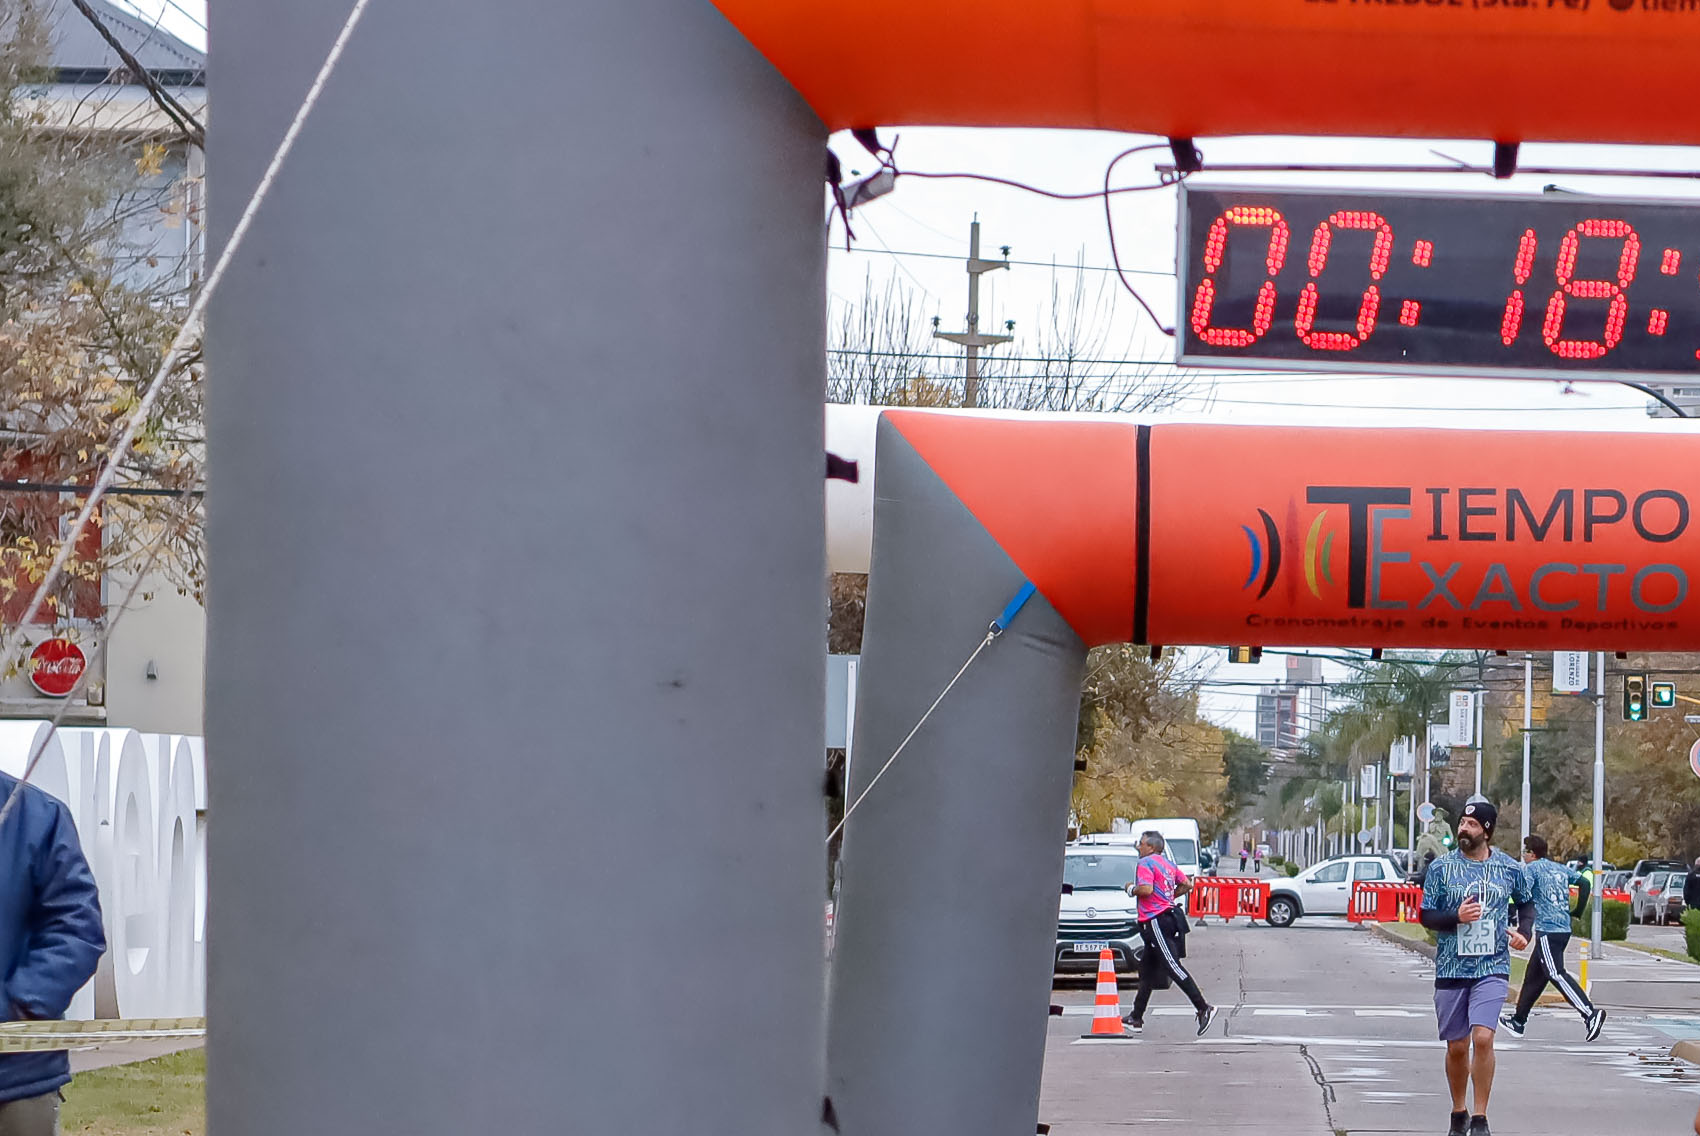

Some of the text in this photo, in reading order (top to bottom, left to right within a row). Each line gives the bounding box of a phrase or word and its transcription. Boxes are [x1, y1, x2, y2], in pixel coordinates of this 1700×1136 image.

[1246, 614, 1679, 632] Cronometraje de Eventos Deportivos
[1462, 940, 1492, 954] Km.
